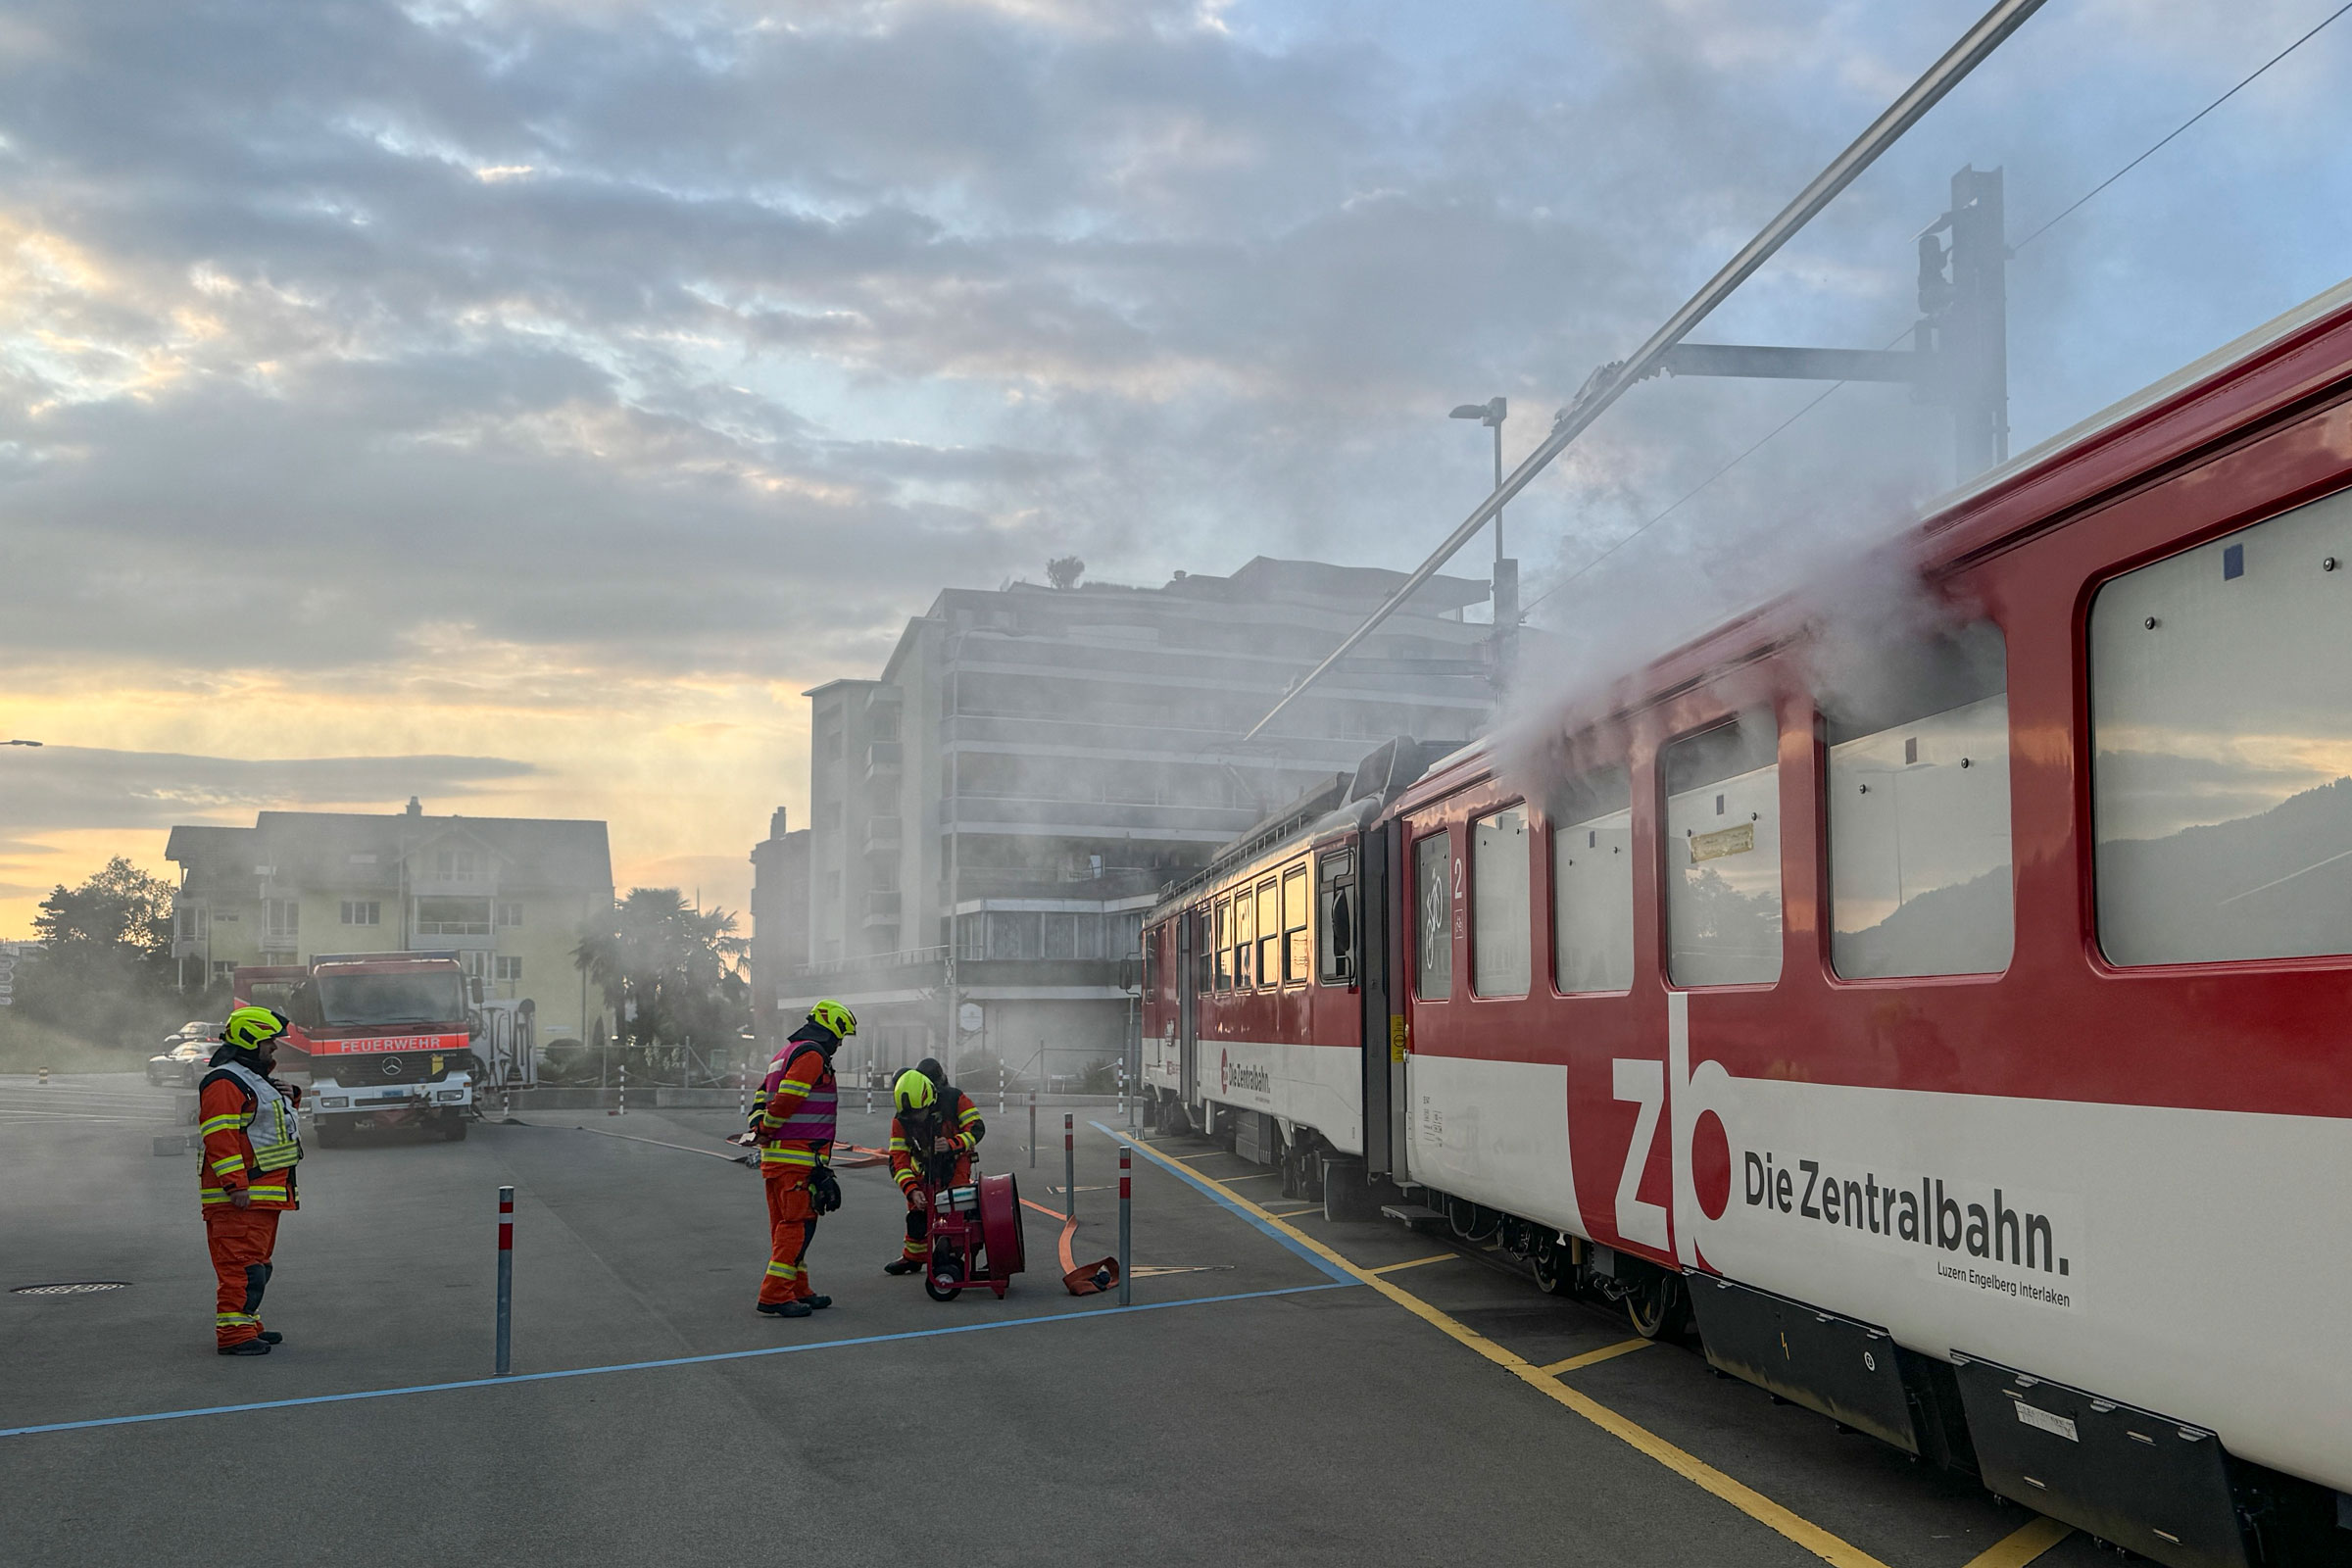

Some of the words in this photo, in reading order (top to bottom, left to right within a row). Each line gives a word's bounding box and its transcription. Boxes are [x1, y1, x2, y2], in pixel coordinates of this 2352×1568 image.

[1454, 858, 1463, 900] 2
[340, 1037, 441, 1053] FEUERWEHR
[1612, 992, 1737, 1275] zb
[1744, 1151, 1793, 1214] Die
[1799, 1158, 2070, 1276] Zentralbahn.
[1937, 1261, 1967, 1282] Luzern
[1969, 1268, 2017, 1297] Engelberg
[2020, 1281, 2070, 1307] Interlaken
